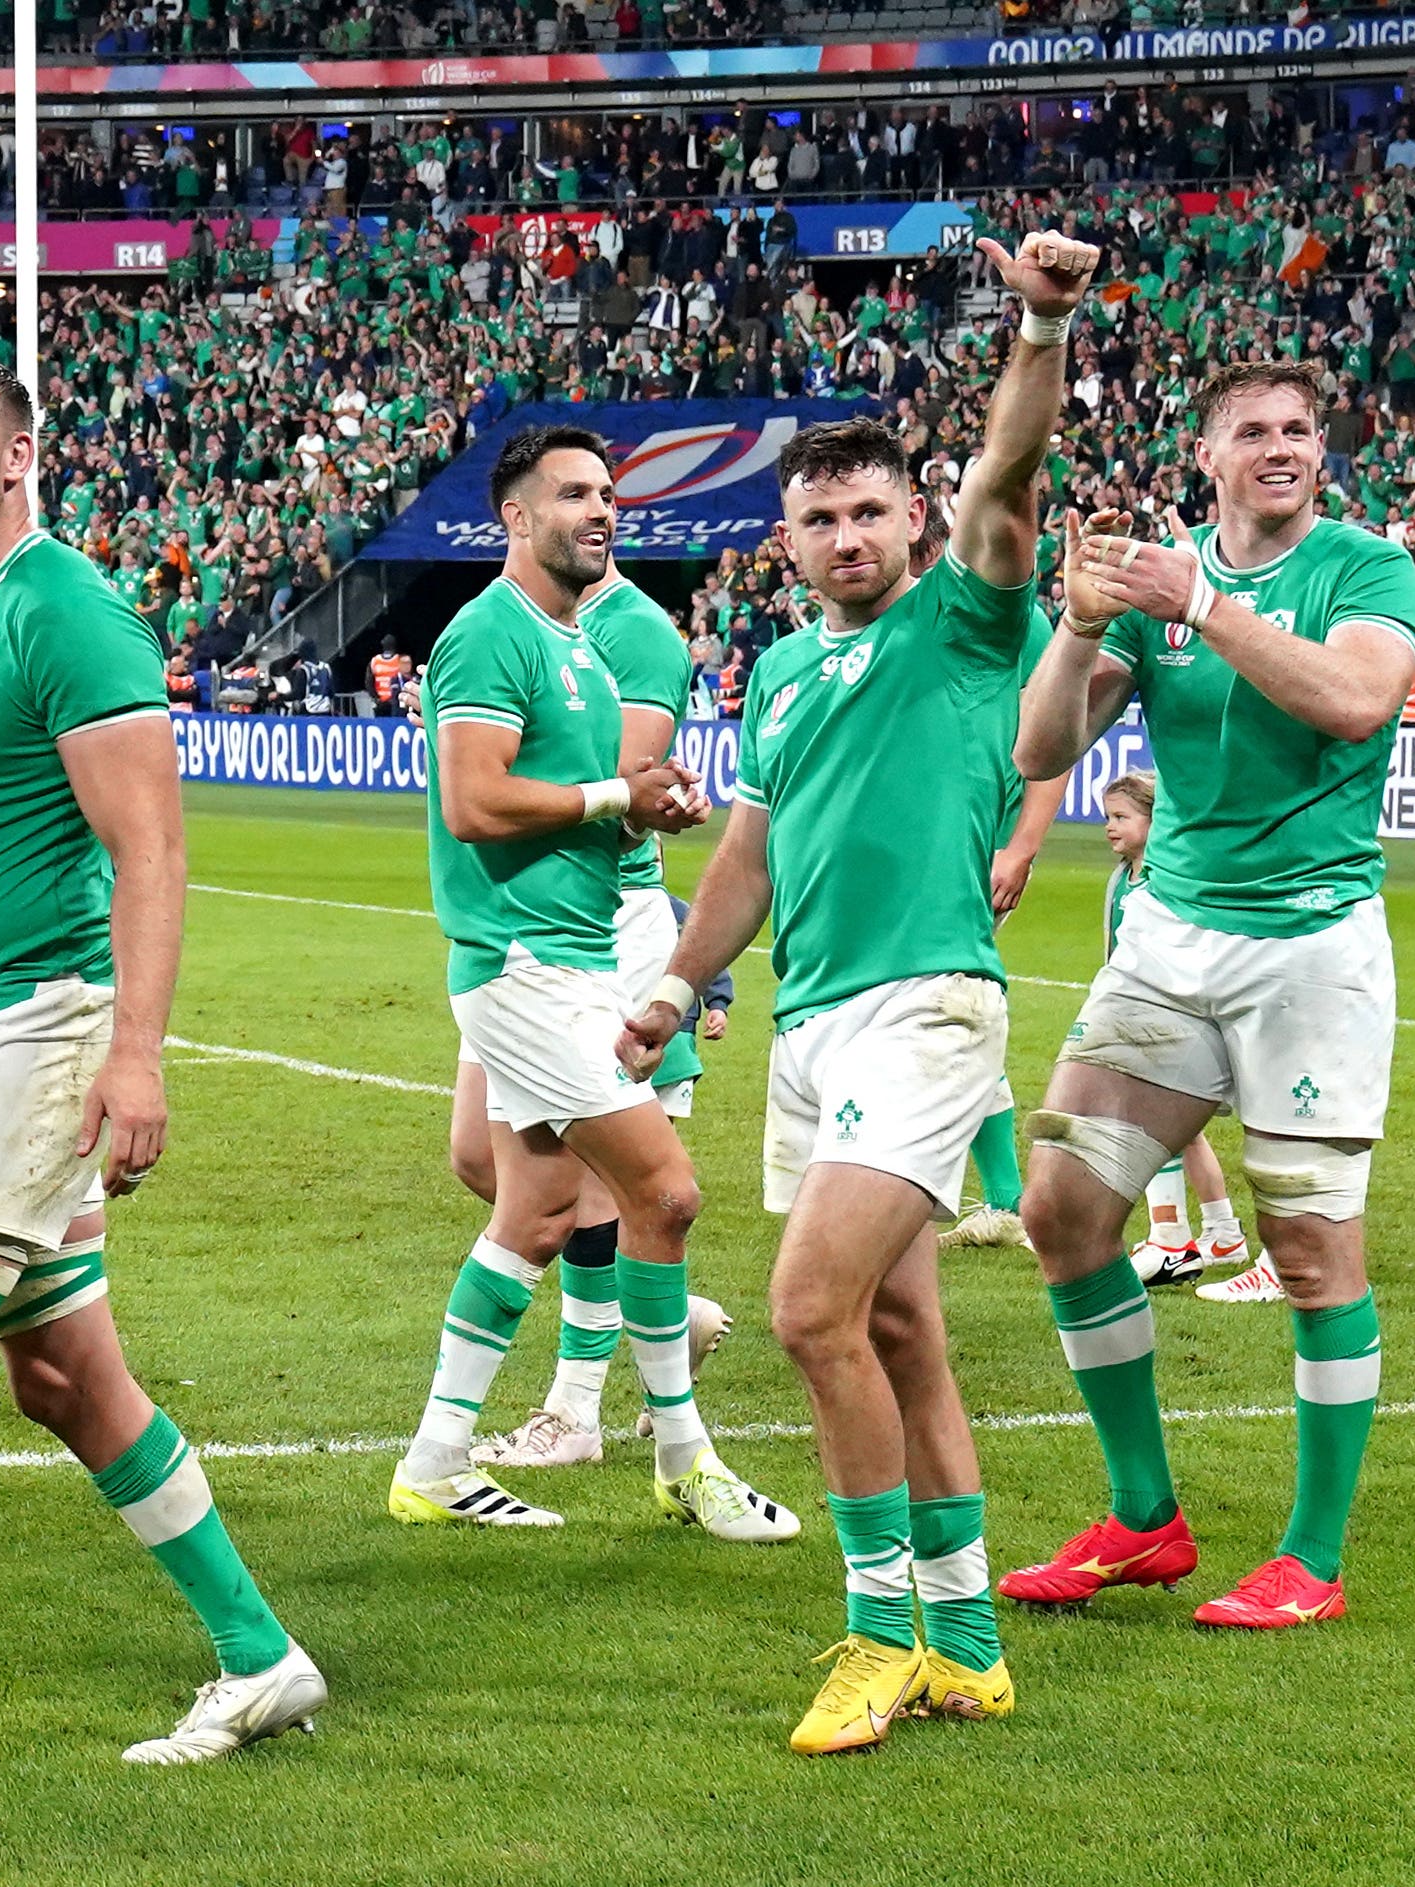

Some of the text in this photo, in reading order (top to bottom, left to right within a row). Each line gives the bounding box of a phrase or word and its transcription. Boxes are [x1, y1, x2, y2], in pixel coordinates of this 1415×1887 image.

[837, 229, 885, 252] R13
[117, 245, 164, 267] R14
[652, 518, 765, 535] CUP
